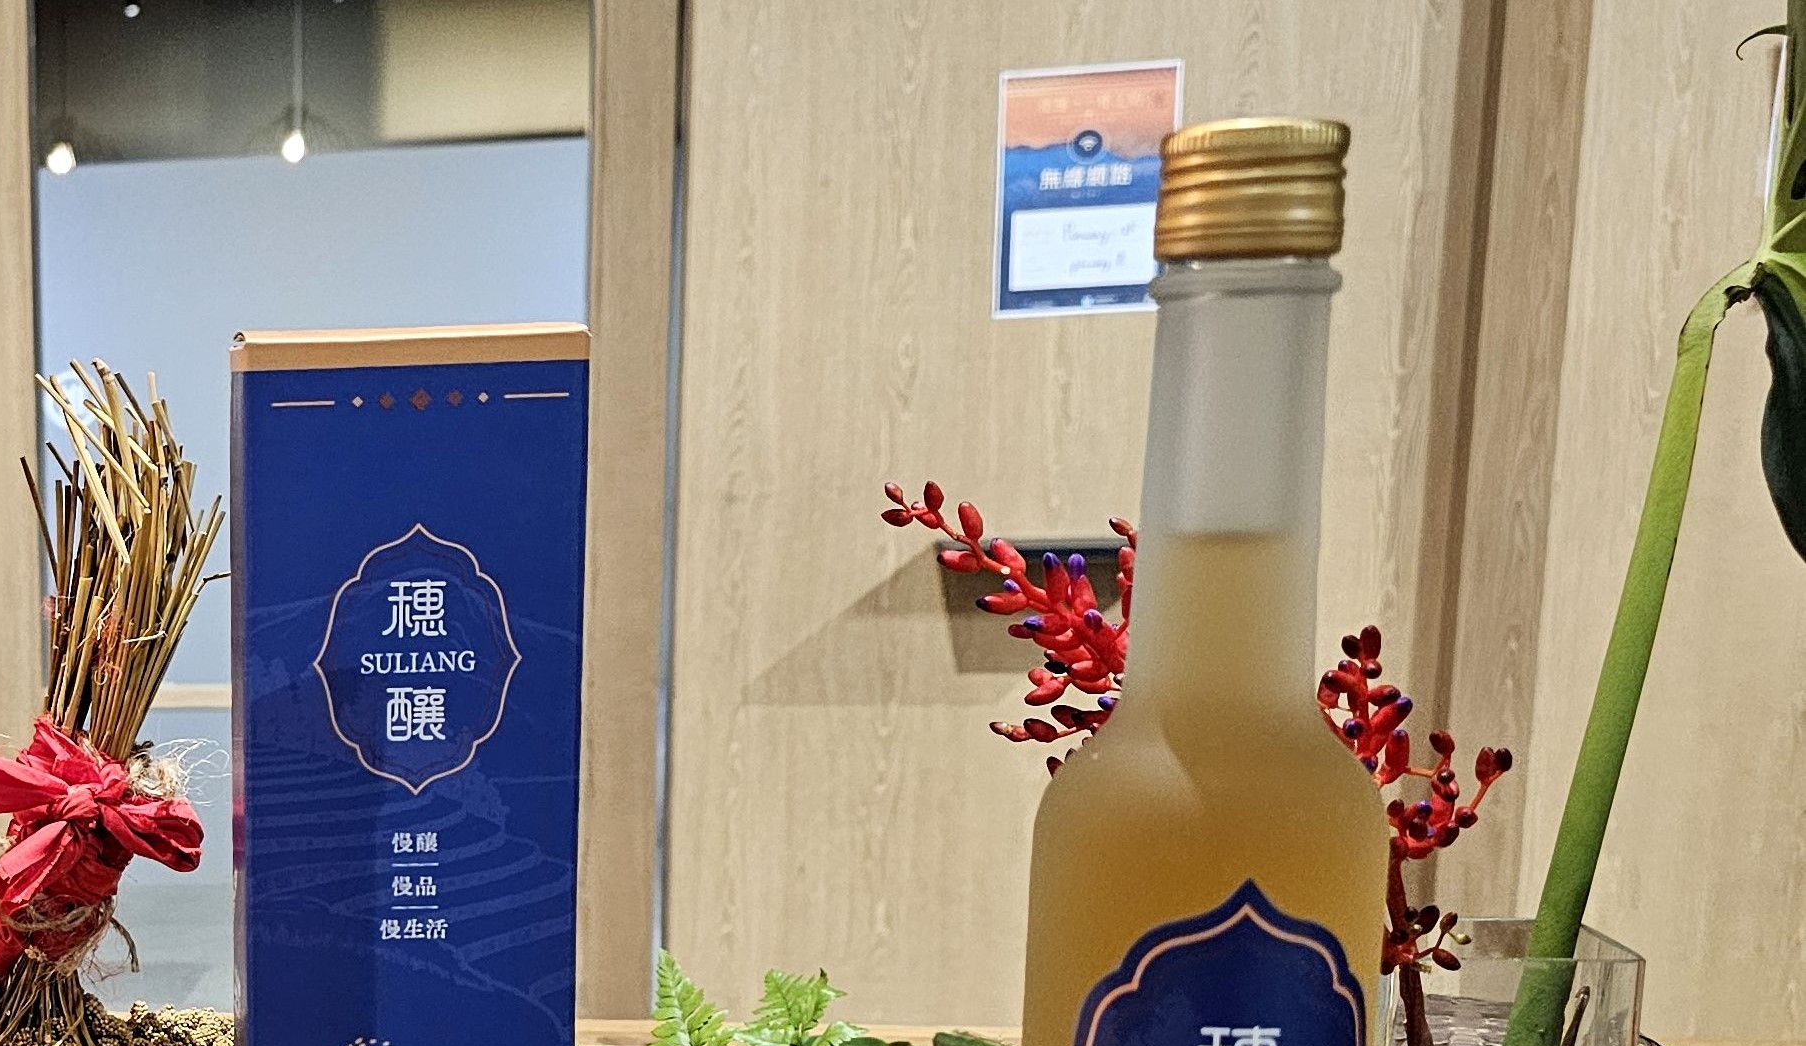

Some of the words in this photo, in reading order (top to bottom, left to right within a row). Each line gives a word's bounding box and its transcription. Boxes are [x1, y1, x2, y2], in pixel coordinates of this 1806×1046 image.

[382, 578, 448, 638] 穗
[360, 650, 476, 675] SULIANG
[385, 686, 447, 742] 釀
[392, 876, 437, 897] 慢品
[380, 919, 448, 940] 慢生活
